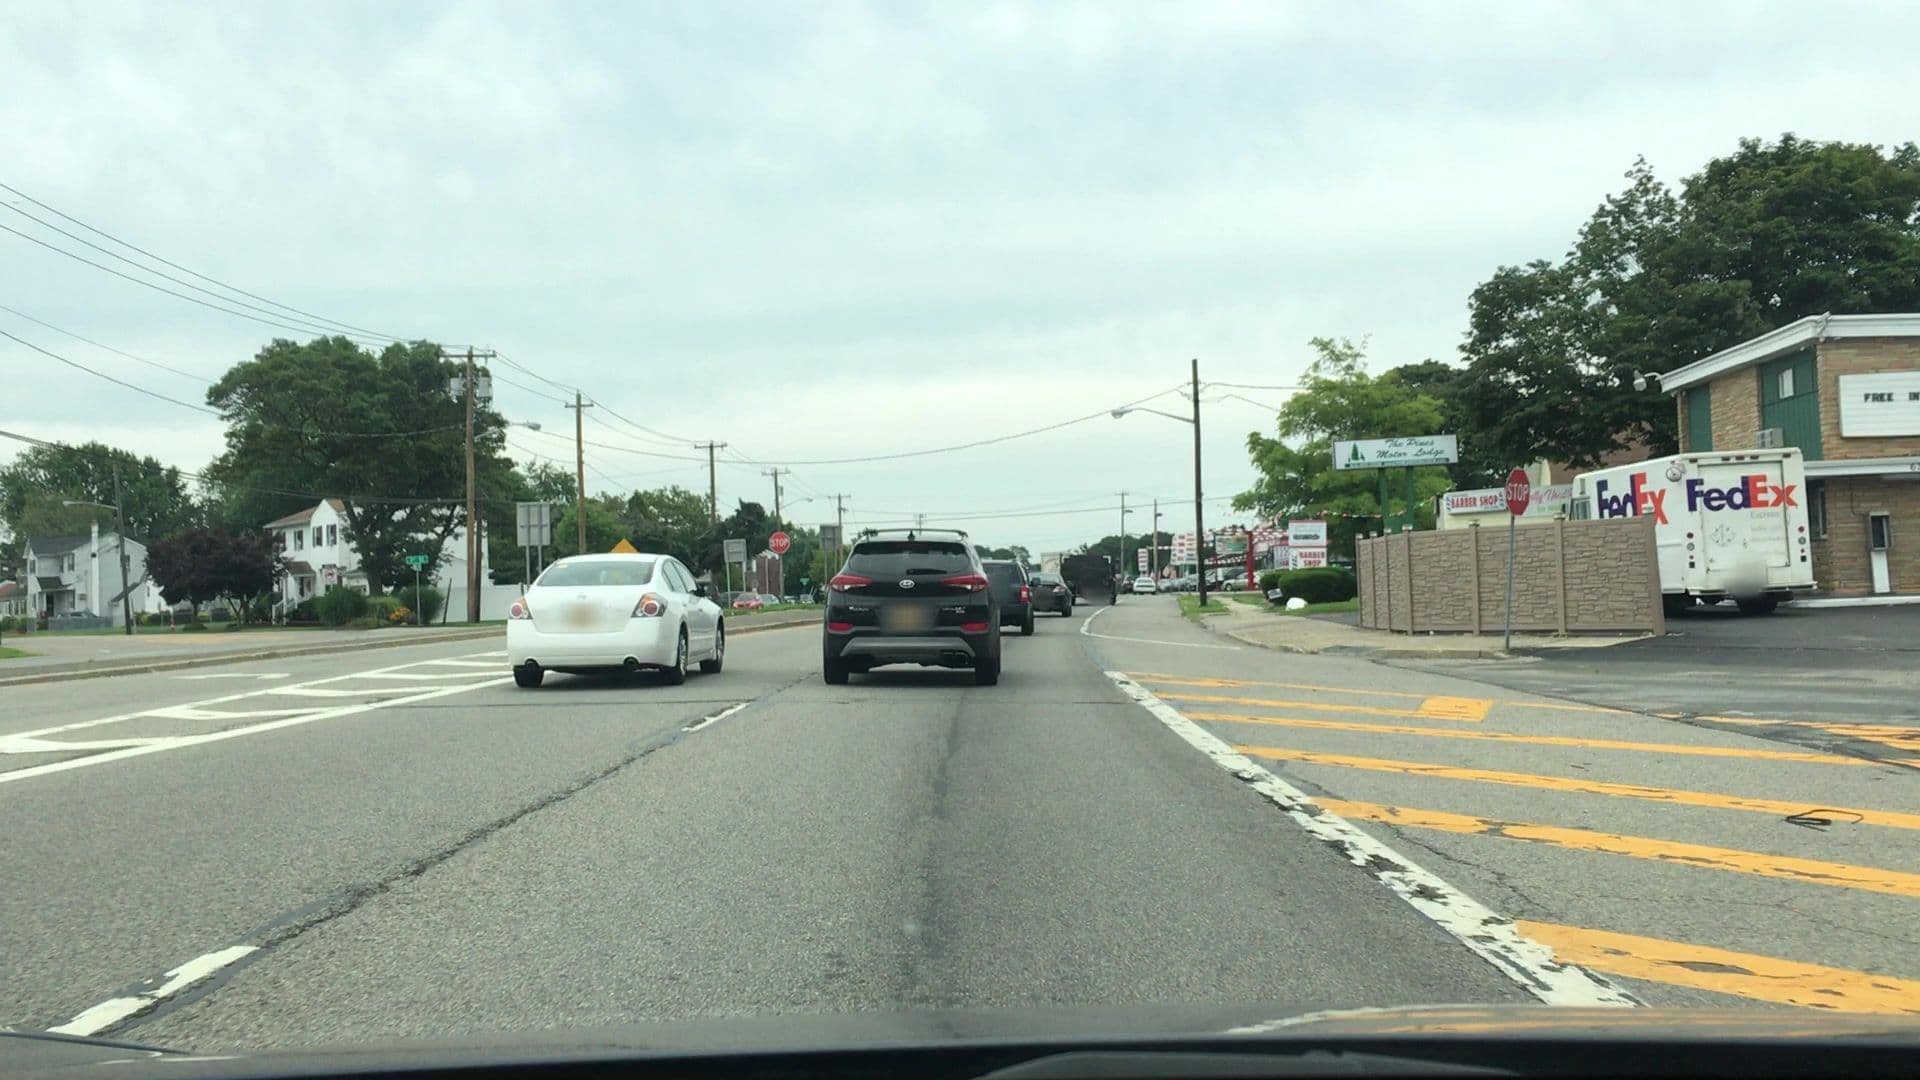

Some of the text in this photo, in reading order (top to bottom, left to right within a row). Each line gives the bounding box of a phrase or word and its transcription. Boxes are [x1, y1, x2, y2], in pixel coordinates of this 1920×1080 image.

[1864, 392, 1894, 403] FREE
[1385, 438, 1434, 448] The Pines
[1376, 447, 1445, 459] Motor Lodge
[1507, 483, 1529, 502] STOP
[1686, 474, 1798, 512] FedEx
[1451, 496, 1477, 508] BARBER
[1480, 495, 1499, 506] SHOP
[770, 538, 789, 548] STOP
